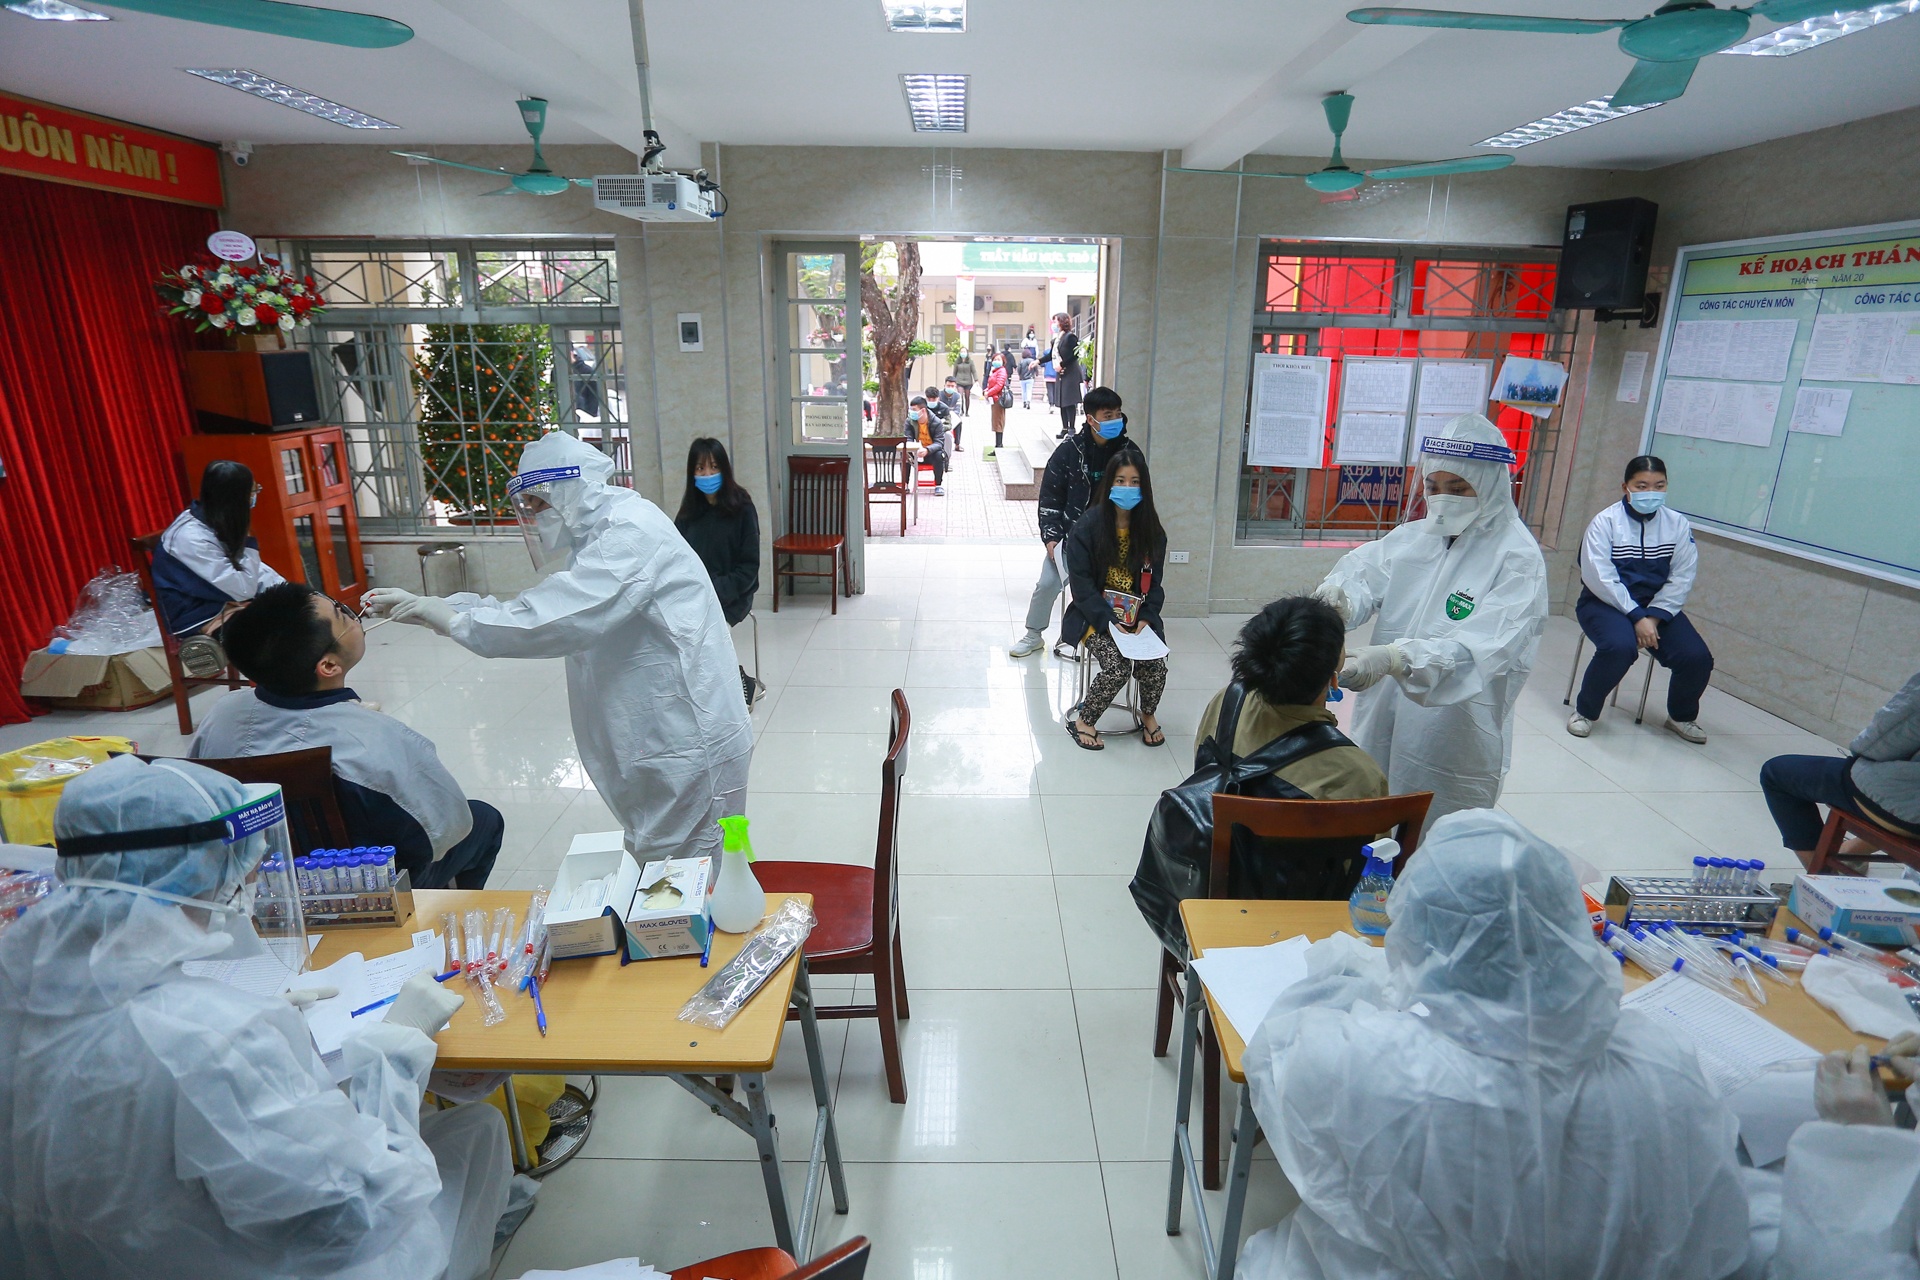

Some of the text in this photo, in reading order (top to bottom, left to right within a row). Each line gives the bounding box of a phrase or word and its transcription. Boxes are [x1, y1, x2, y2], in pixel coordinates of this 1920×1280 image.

[83, 133, 162, 181] NĂM
[1738, 255, 1767, 276] KẾ
[1769, 254, 1846, 274] HOẠCH
[1790, 274, 1864, 284] THÁNG NĂM 20
[1699, 296, 1794, 310] CÔNG TÁC CHUYÊN MÔN
[1854, 292, 1886, 304] CÔNG
[1889, 291, 1911, 303] TÁC
[1446, 442, 1472, 450] SHIELD
[1359, 482, 1372, 500] CHO
[1802, 884, 1834, 910] MAX GLOVES
[659, 919, 688, 927] GLOVES
